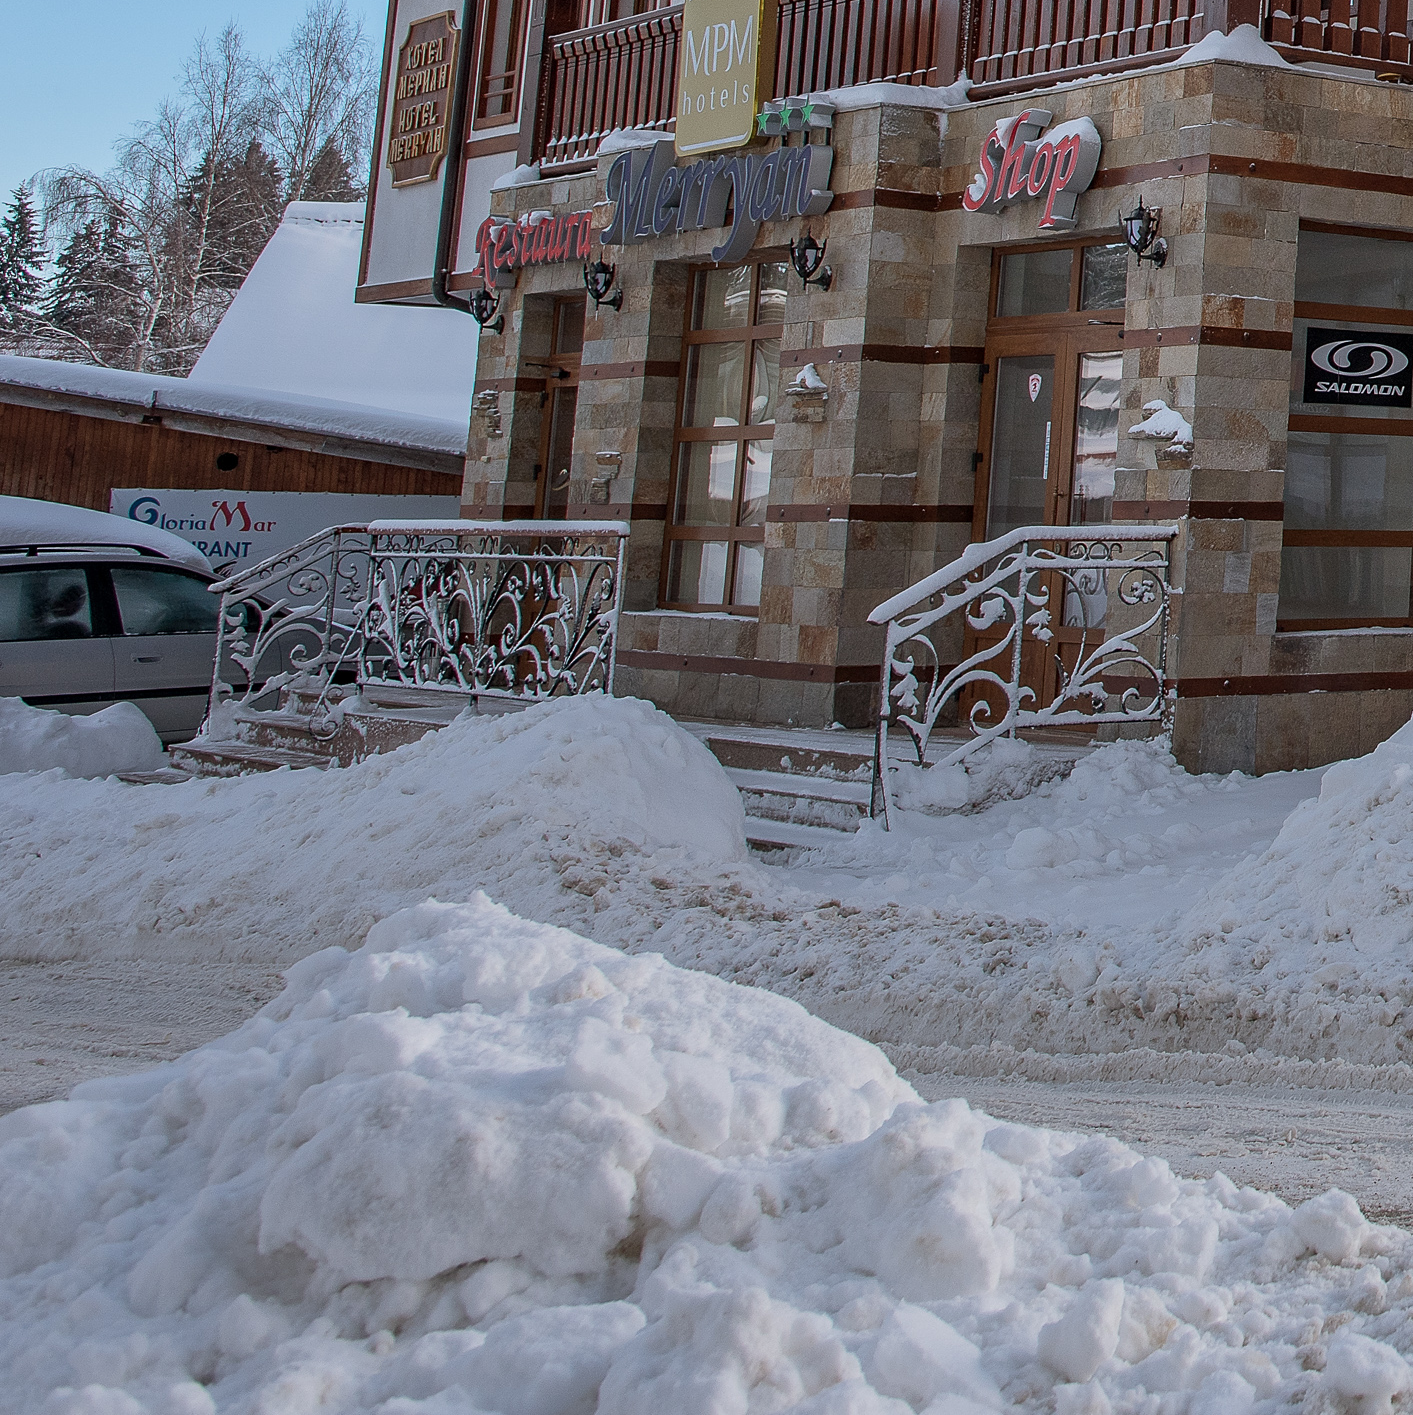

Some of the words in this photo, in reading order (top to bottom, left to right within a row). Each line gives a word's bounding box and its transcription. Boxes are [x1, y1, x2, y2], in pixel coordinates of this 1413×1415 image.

[405, 37, 447, 71] ХОТЕЛ
[684, 15, 754, 78] MPM
[682, 80, 751, 116] hotels
[398, 100, 440, 133] HOTEL
[388, 126, 445, 163] MERRYAN
[961, 110, 1083, 230] Shop
[600, 141, 820, 262] Merryan
[1314, 381, 1406, 397] SALOMON
[128, 496, 207, 531] Gloria
[192, 540, 253, 558] RANT
